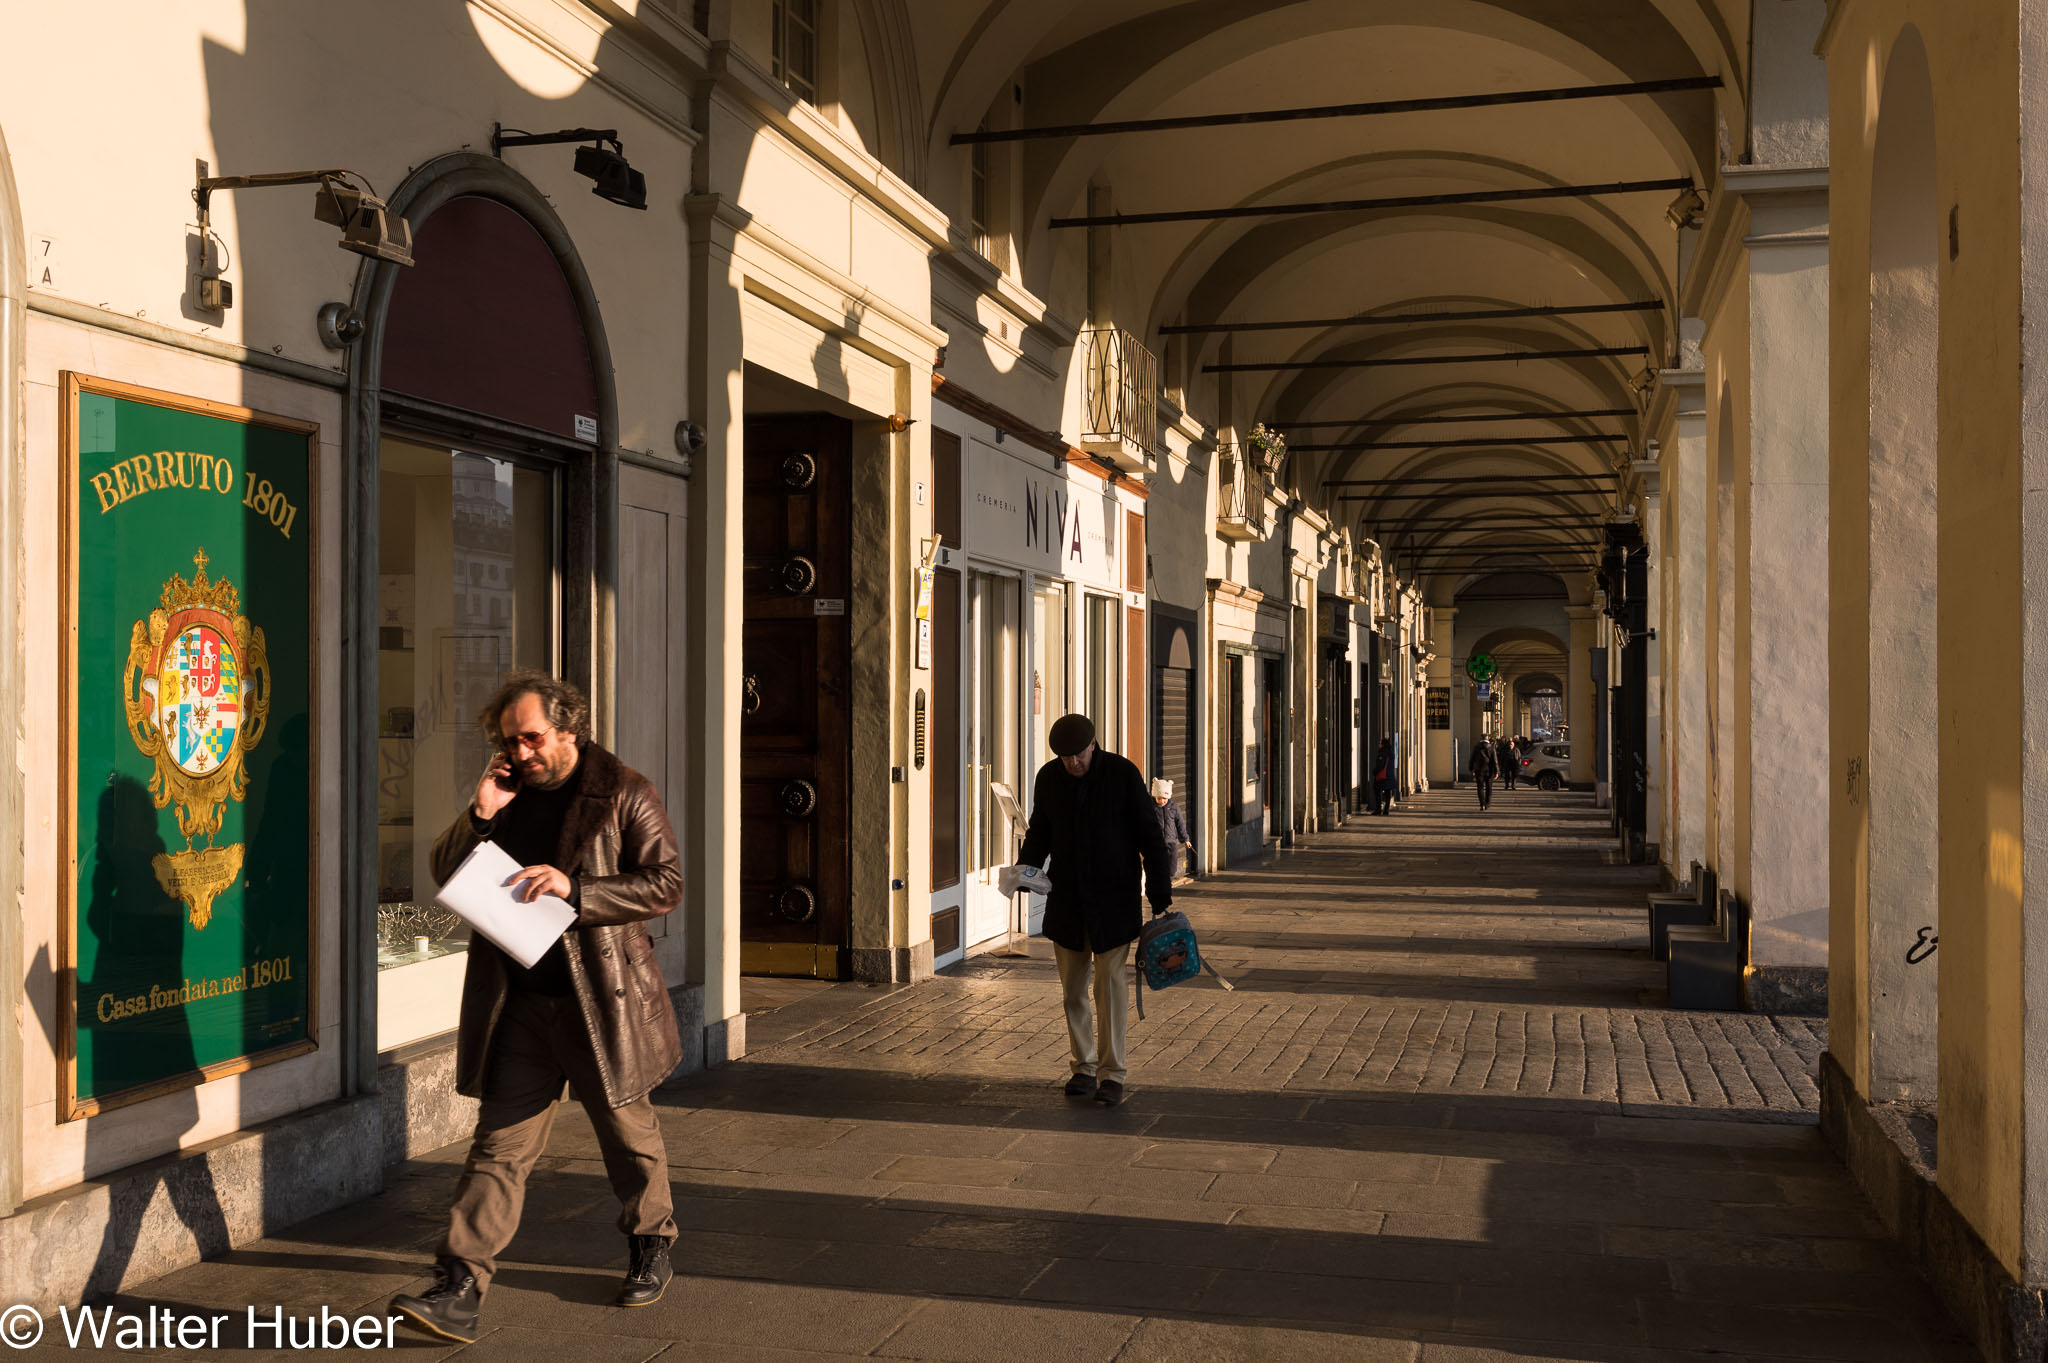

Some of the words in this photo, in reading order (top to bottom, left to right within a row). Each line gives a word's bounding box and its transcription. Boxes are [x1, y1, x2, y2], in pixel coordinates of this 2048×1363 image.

[42, 240, 51, 256] 7
[42, 266, 52, 285] A
[89, 450, 233, 515] BERRUTO
[242, 471, 297, 540] 1801
[977, 493, 1017, 513] CREMERIA
[1025, 475, 1083, 563] NIVA
[97, 993, 148, 1024] Casa
[147, 976, 221, 1011] fondata
[221, 967, 248, 993] nel
[250, 955, 293, 989] 1801
